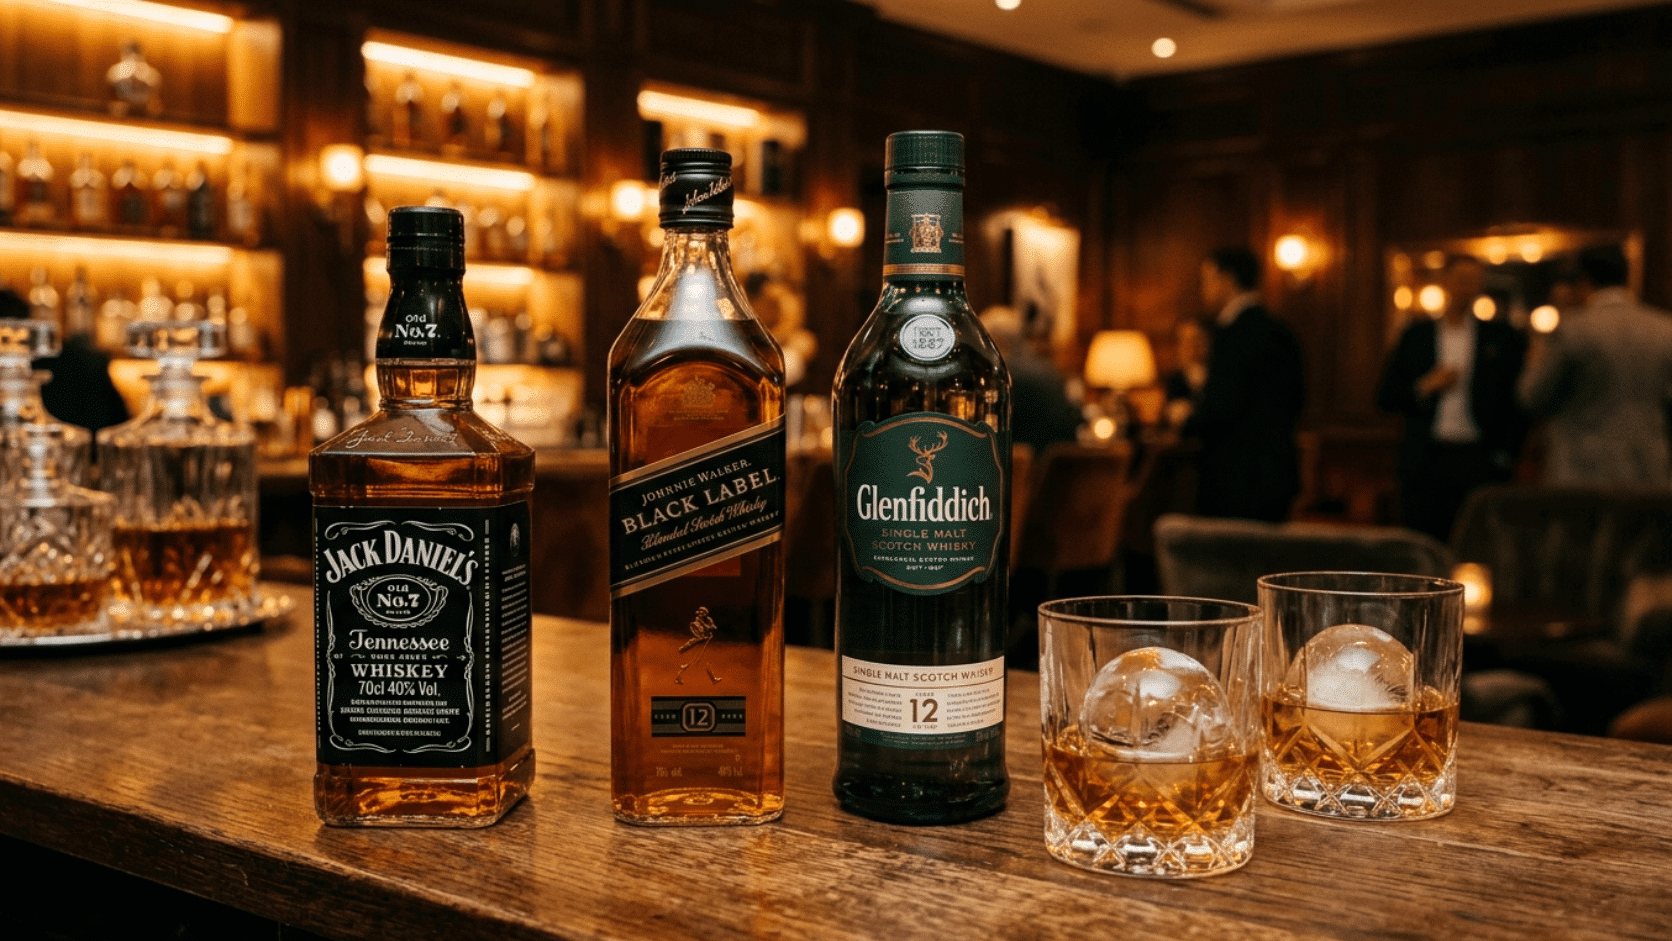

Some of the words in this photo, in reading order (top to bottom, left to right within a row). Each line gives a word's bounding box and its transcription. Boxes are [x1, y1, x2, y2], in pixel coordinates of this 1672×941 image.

[856, 483, 991, 522] Glenfiddich
[621, 494, 699, 535] BLACK
[934, 528, 967, 539] MALT
[323, 538, 384, 584] JACK
[384, 530, 479, 586] DANIEL'S
[349, 628, 450, 651] Tennessee
[350, 663, 449, 679] WHISKEY
[853, 666, 882, 679] SINGLE
[885, 671, 910, 681] MALT
[913, 672, 958, 682] SCOTCH
[358, 681, 385, 696] 70cl
[387, 681, 416, 696] 40%
[418, 681, 441, 697] Vol.
[689, 708, 709, 726] 12
[909, 698, 939, 723] 12
